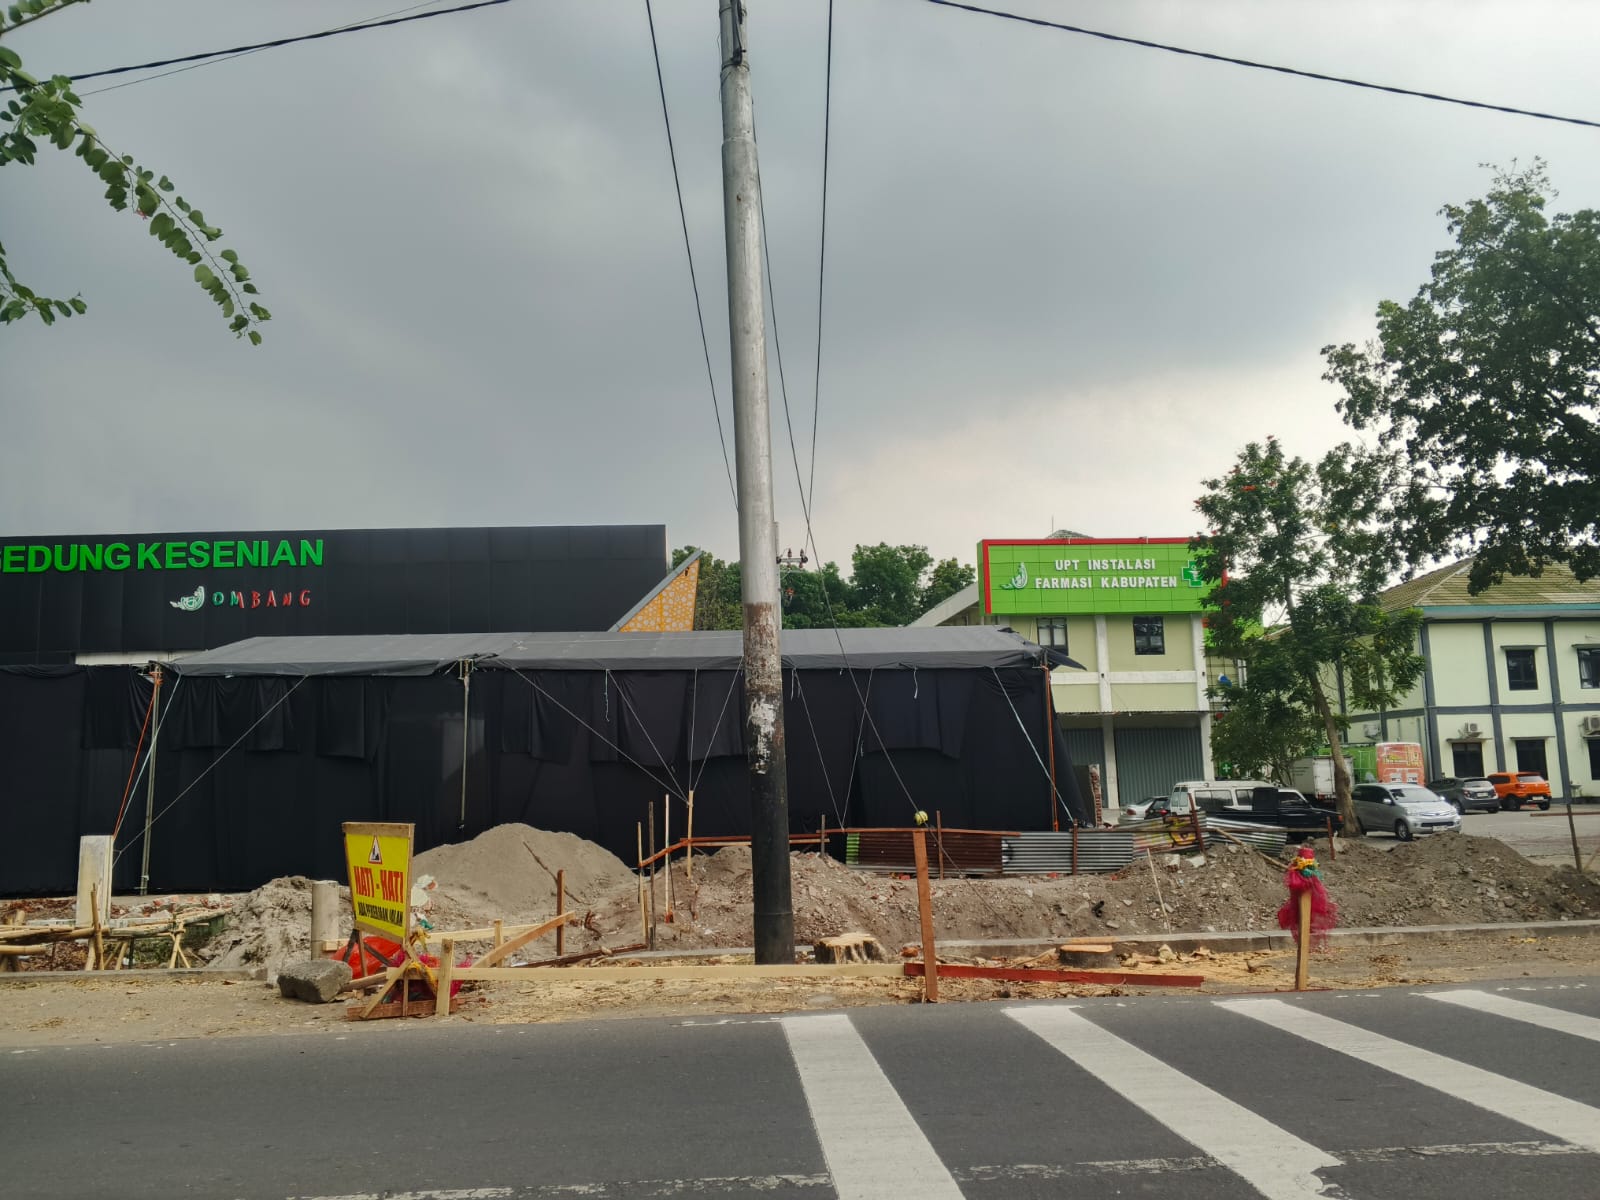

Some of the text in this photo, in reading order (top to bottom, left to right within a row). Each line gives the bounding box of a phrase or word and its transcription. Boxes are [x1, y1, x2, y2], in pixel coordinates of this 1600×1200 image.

[0, 539, 324, 573] EDUNG KESENIAN
[1055, 558, 1155, 571] UPT INSTALASI
[1035, 576, 1177, 589] FARMASI KABUPATEN
[353, 865, 375, 898] HATI
[380, 869, 404, 904] HATI
